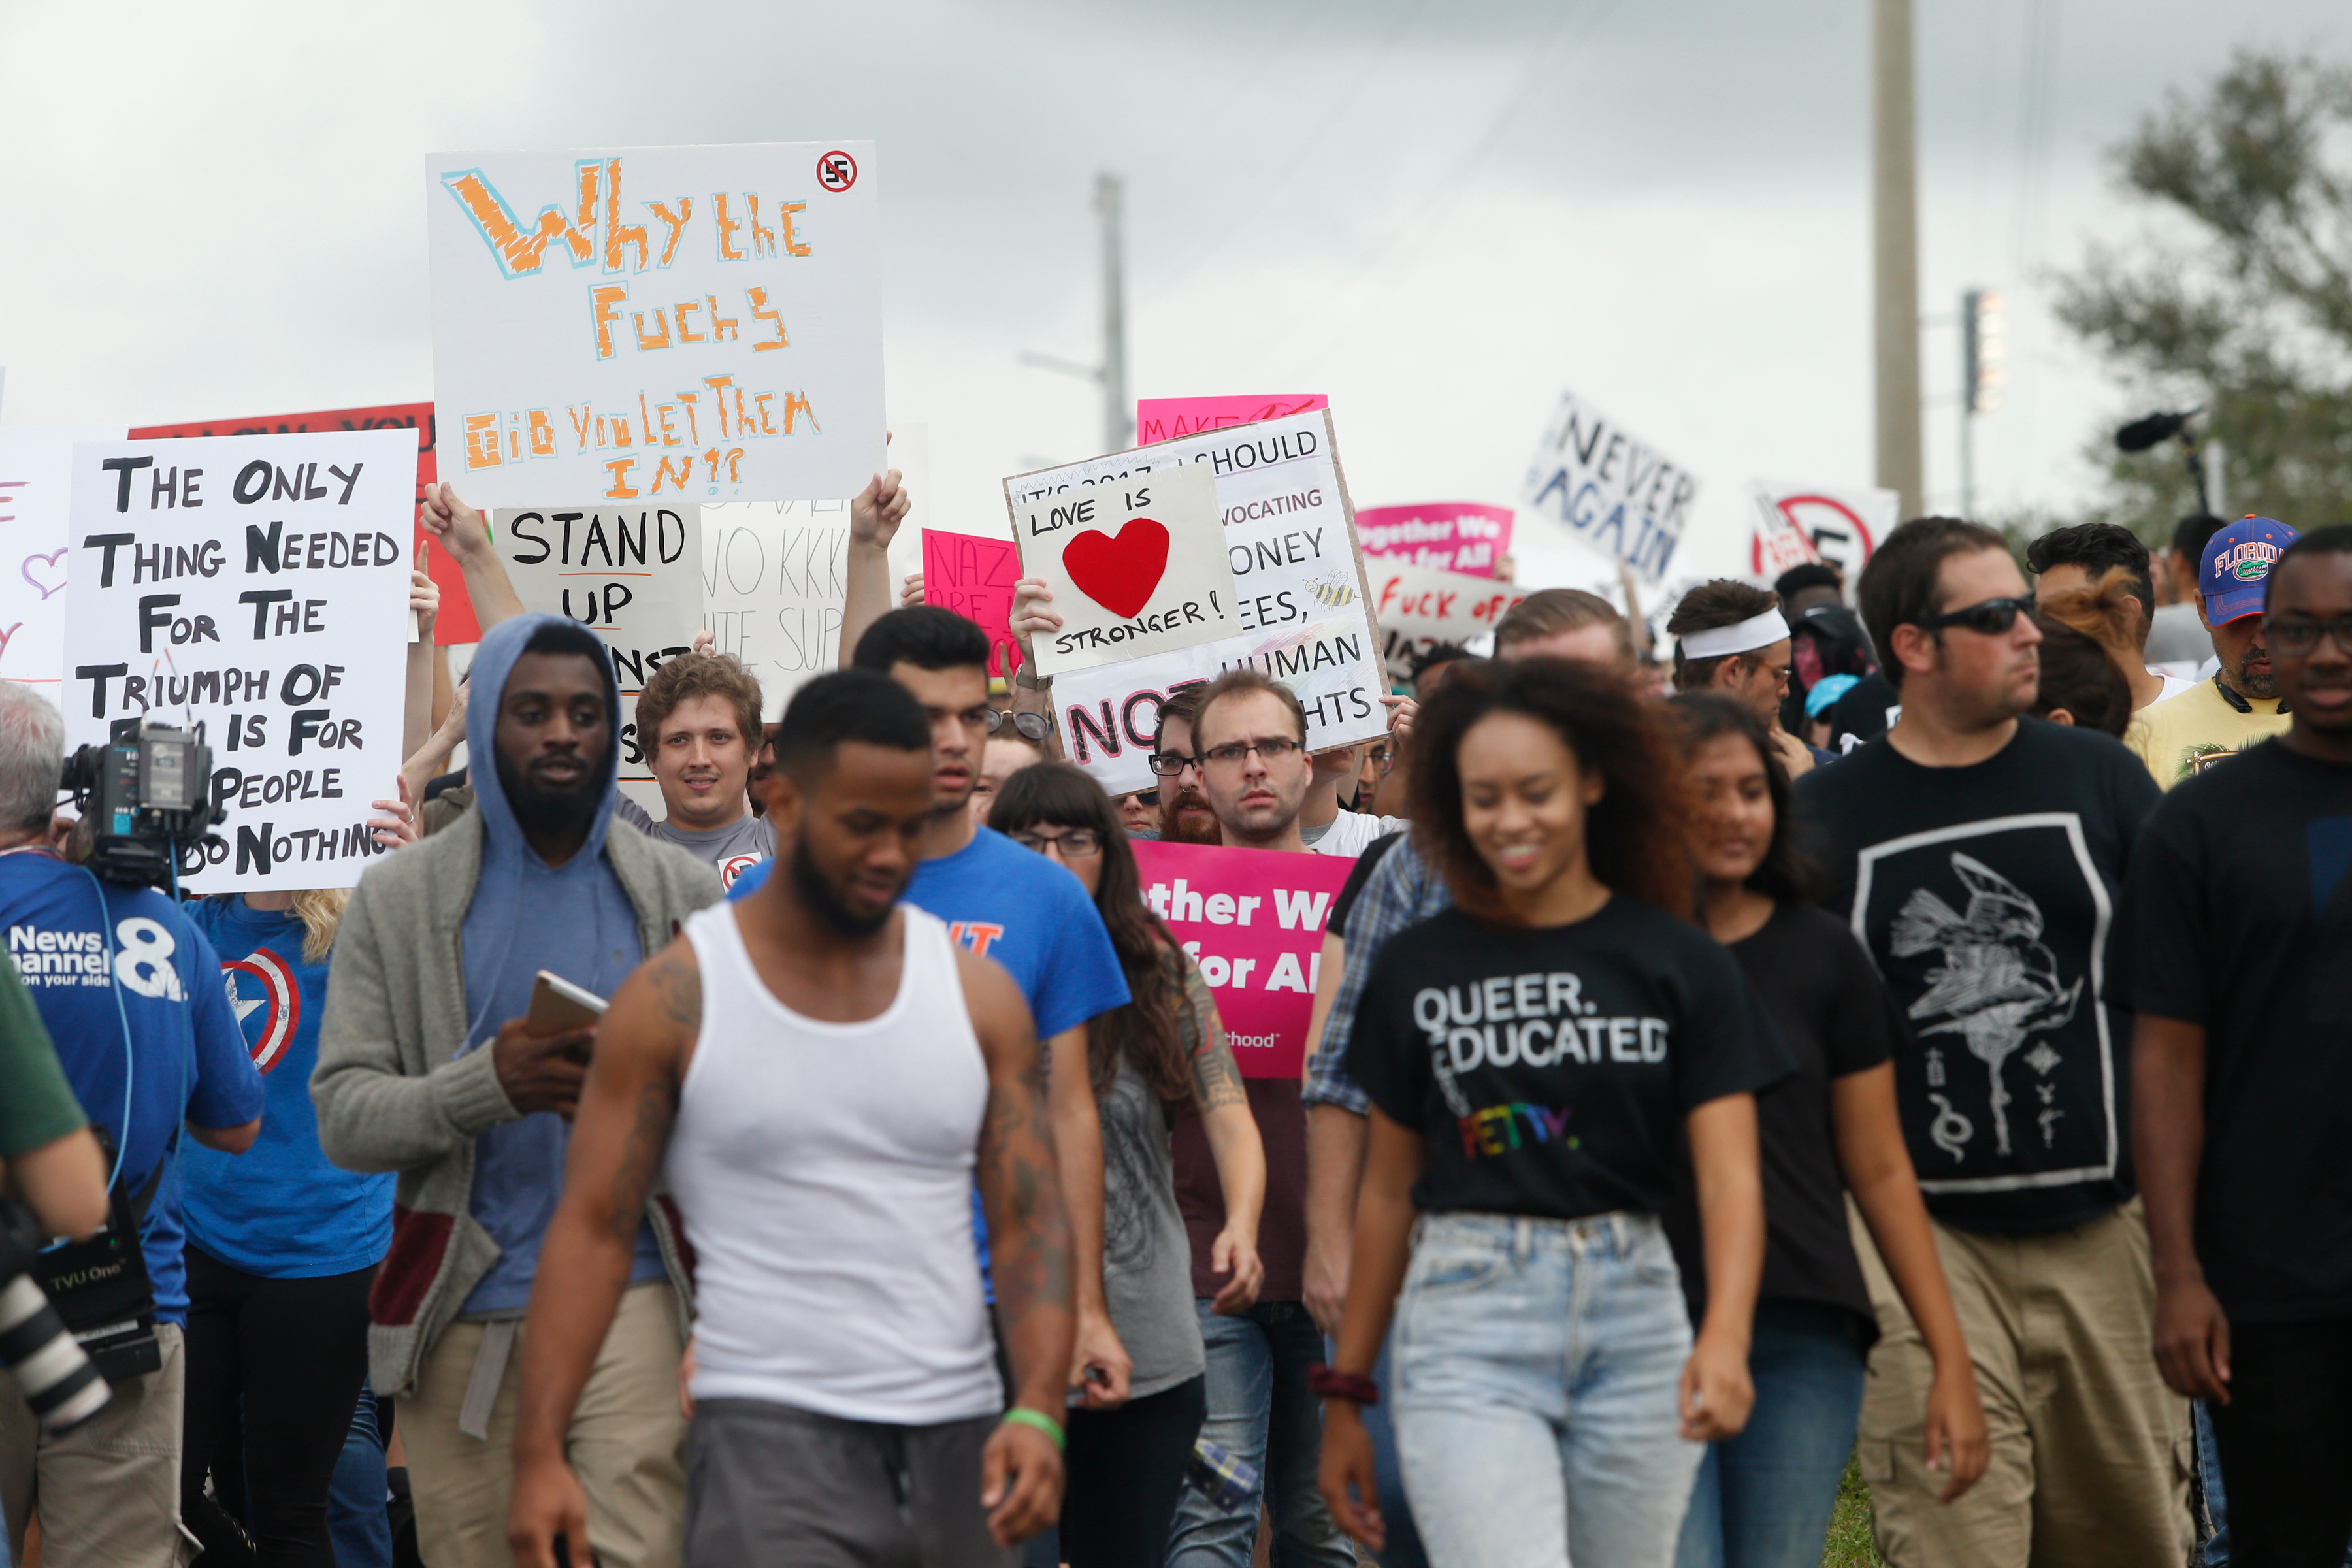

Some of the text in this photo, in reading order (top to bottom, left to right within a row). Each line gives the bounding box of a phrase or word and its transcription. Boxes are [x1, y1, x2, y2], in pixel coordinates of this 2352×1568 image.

[440, 157, 694, 280] Why
[1556, 409, 1695, 530] NEVER
[1030, 487, 1151, 537] LOVE IS
[1222, 489, 1323, 527] VOCATING
[1535, 466, 1677, 578] AGAIN
[511, 509, 685, 567] STAND
[1229, 527, 1324, 576] ONEY
[1356, 517, 1455, 551] ogether
[779, 527, 846, 600] KKK
[930, 535, 1015, 589] NAZ
[562, 583, 633, 625] UP
[1054, 590, 1224, 655] STRONGER!
[1238, 591, 1308, 631] EES,
[773, 606, 843, 672] SUP
[227, 713, 268, 751] IS
[1299, 687, 1371, 730] HTS
[1139, 878, 1332, 932] ther W
[8, 947, 111, 975] hannel
[10, 925, 103, 953] News
[20, 973, 111, 988] on your side
[1264, 951, 1322, 994] Al
[1413, 972, 1598, 1034] QUEER.
[50, 1269, 86, 1291] TVU
